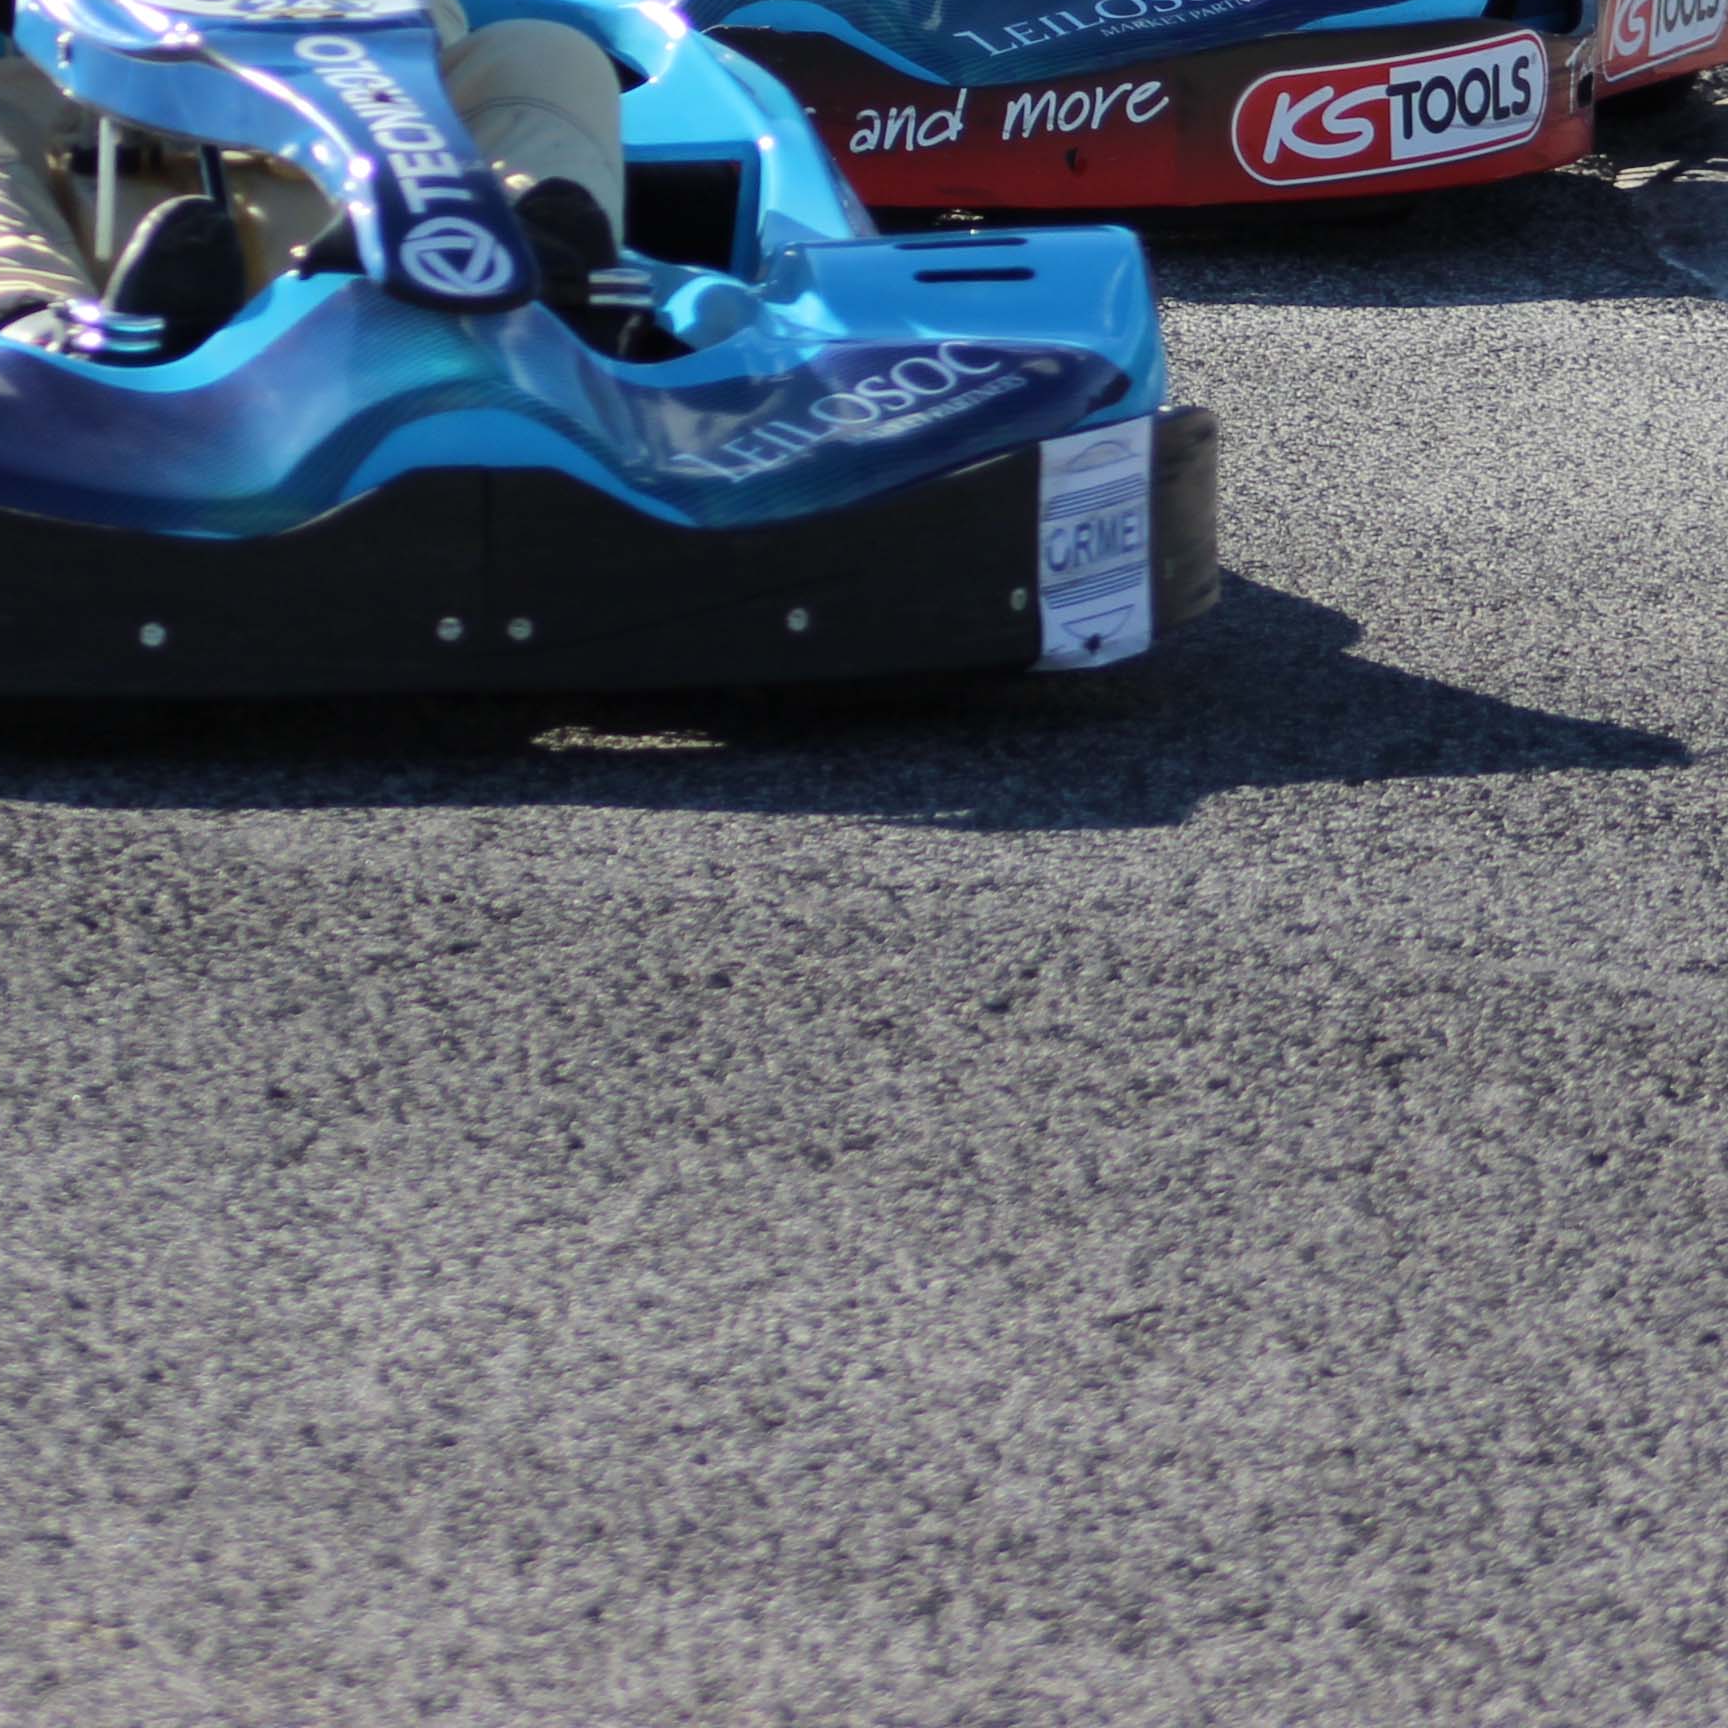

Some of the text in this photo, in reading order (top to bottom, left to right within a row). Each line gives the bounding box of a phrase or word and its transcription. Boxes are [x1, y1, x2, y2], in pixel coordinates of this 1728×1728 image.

[1100, 8, 1187, 38] MARKET
[294, 35, 476, 215] TECNIROLO
[849, 79, 1170, 153] and more
[669, 340, 1002, 484] LEILOSOC
